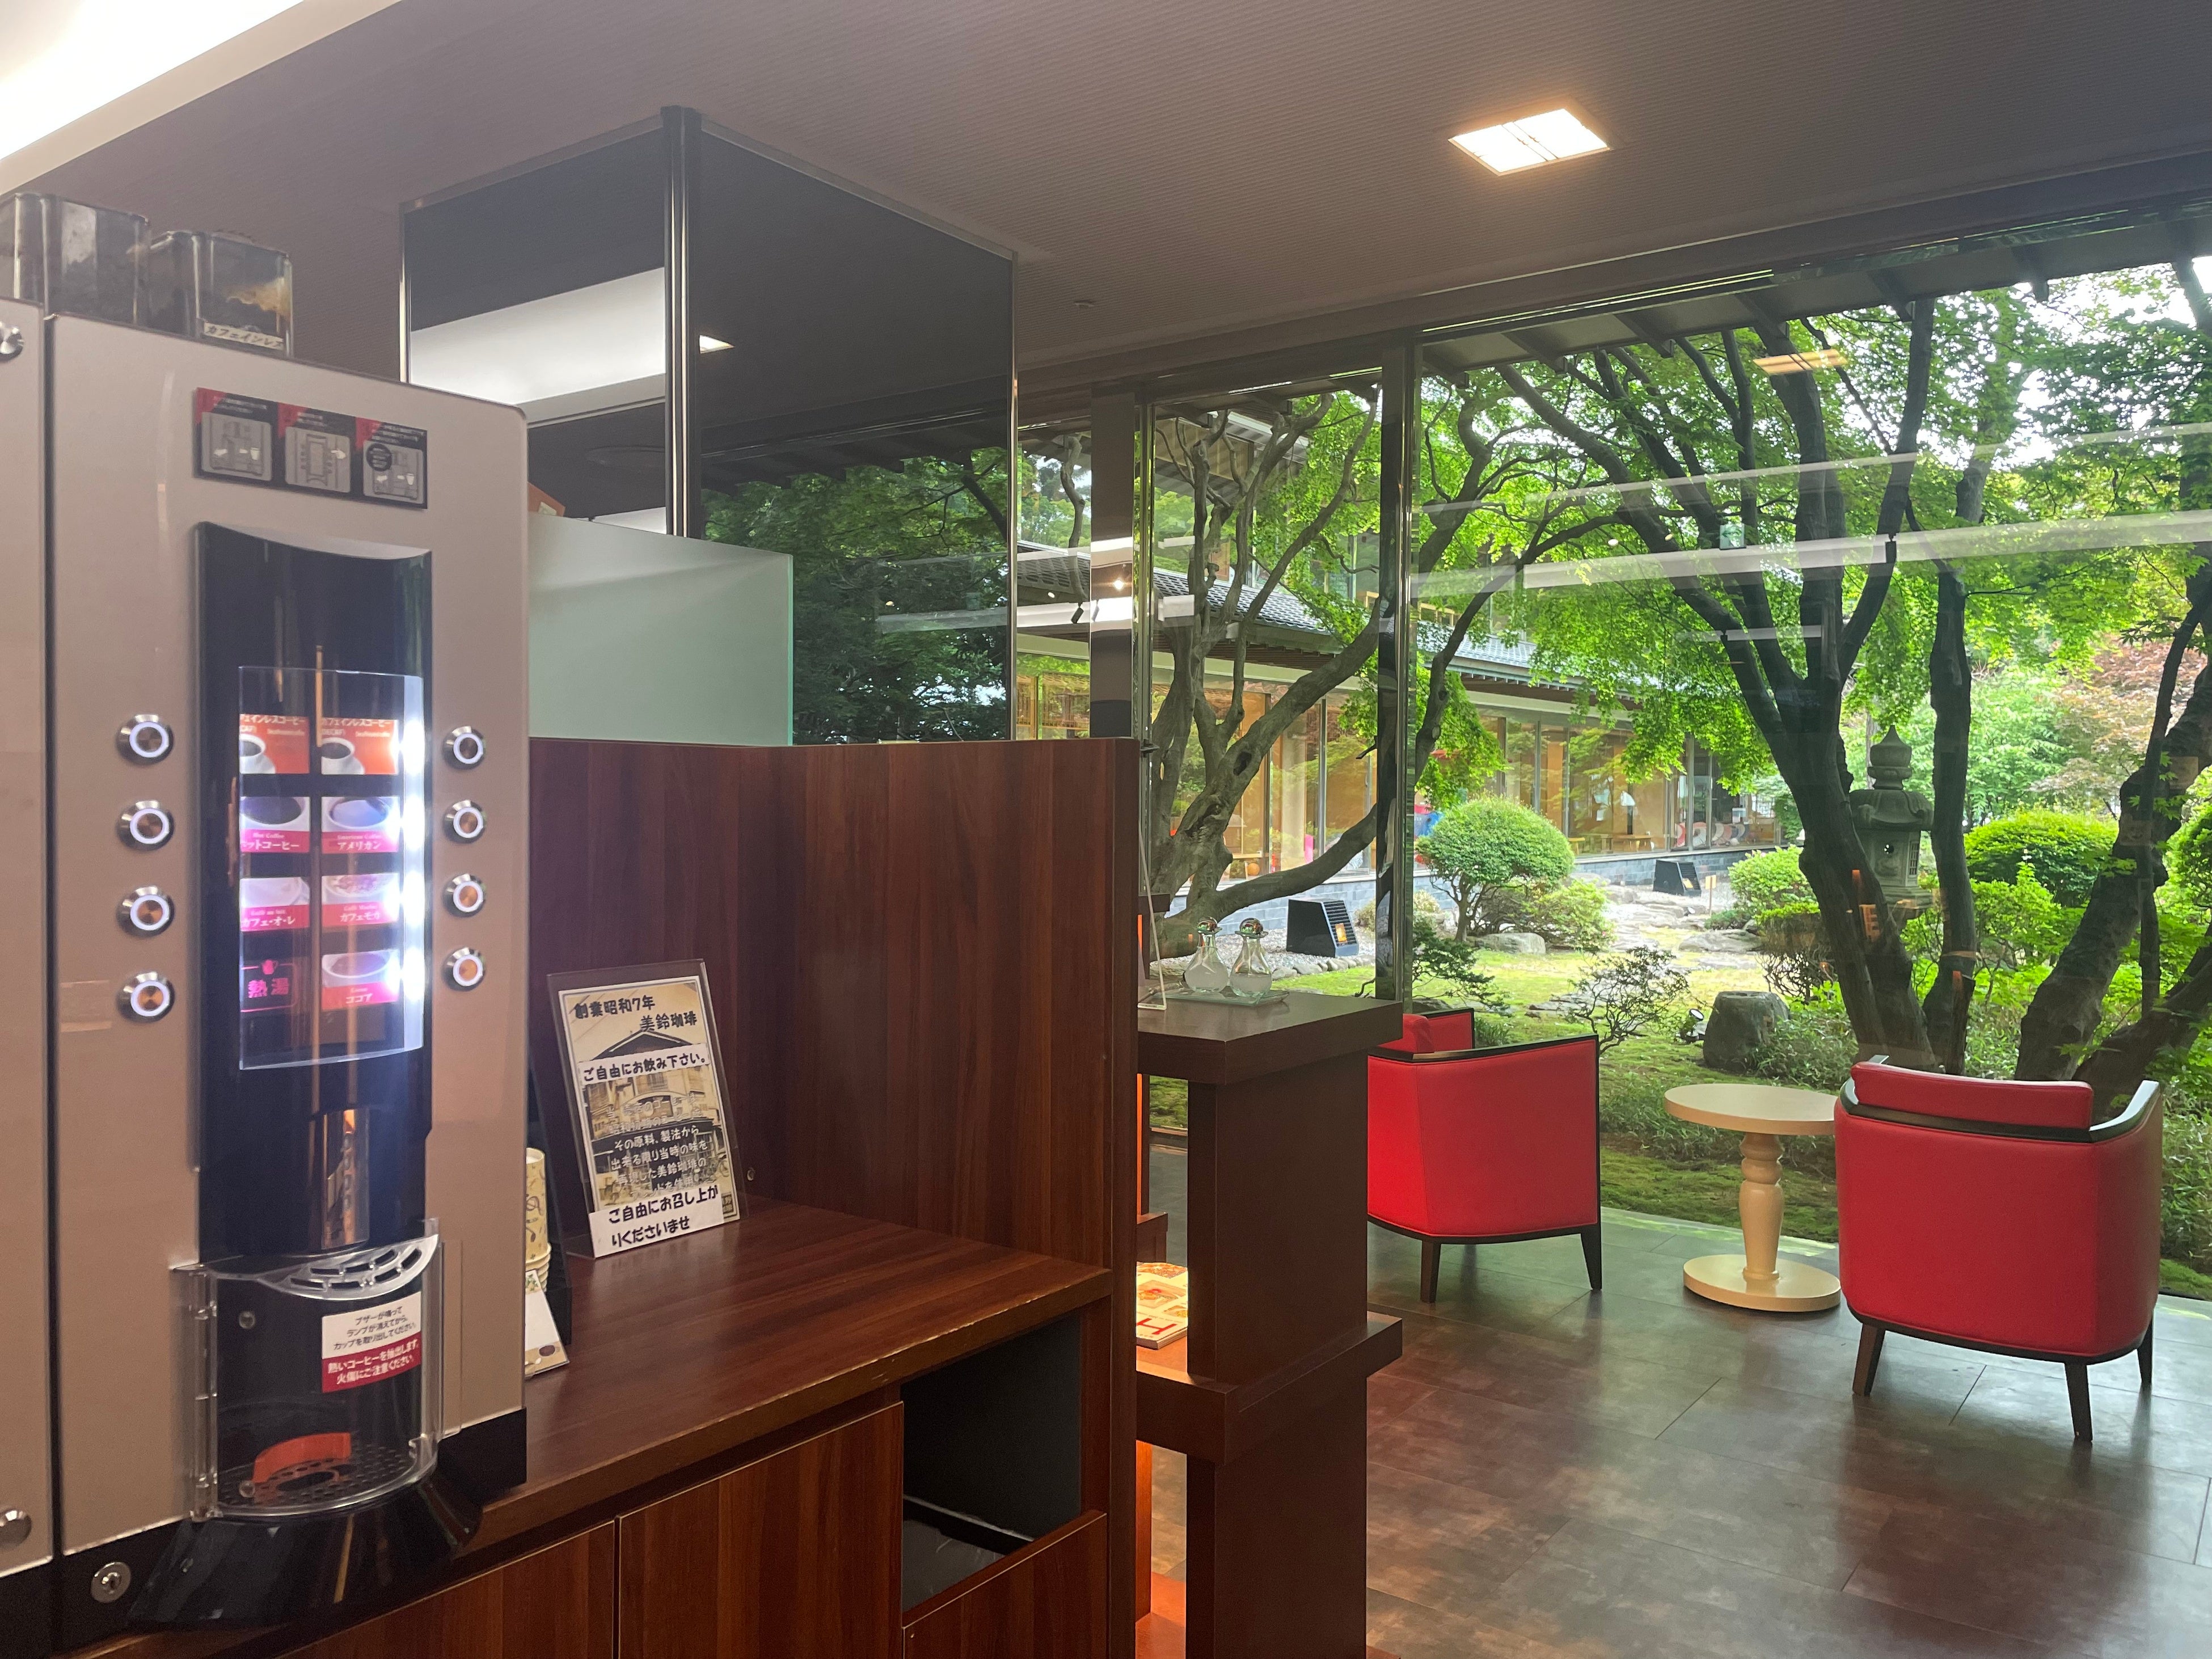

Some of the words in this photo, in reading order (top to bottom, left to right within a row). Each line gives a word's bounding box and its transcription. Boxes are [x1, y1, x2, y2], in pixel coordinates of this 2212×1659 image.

[337, 841, 382, 851] アメリカン
[345, 993, 373, 1004] ココア
[574, 994, 656, 1019] 創業昭和7年
[639, 1011, 698, 1032] 美鈴珈琲
[584, 1053, 706, 1082] ご自由にお飲み下さい。
[614, 1125, 700, 1151] その原料、製法から
[611, 1140, 708, 1171] 出来る限り当時の味を
[609, 1185, 719, 1224] ご自由にお召し上が
[612, 1215, 690, 1247] りくださいませ
